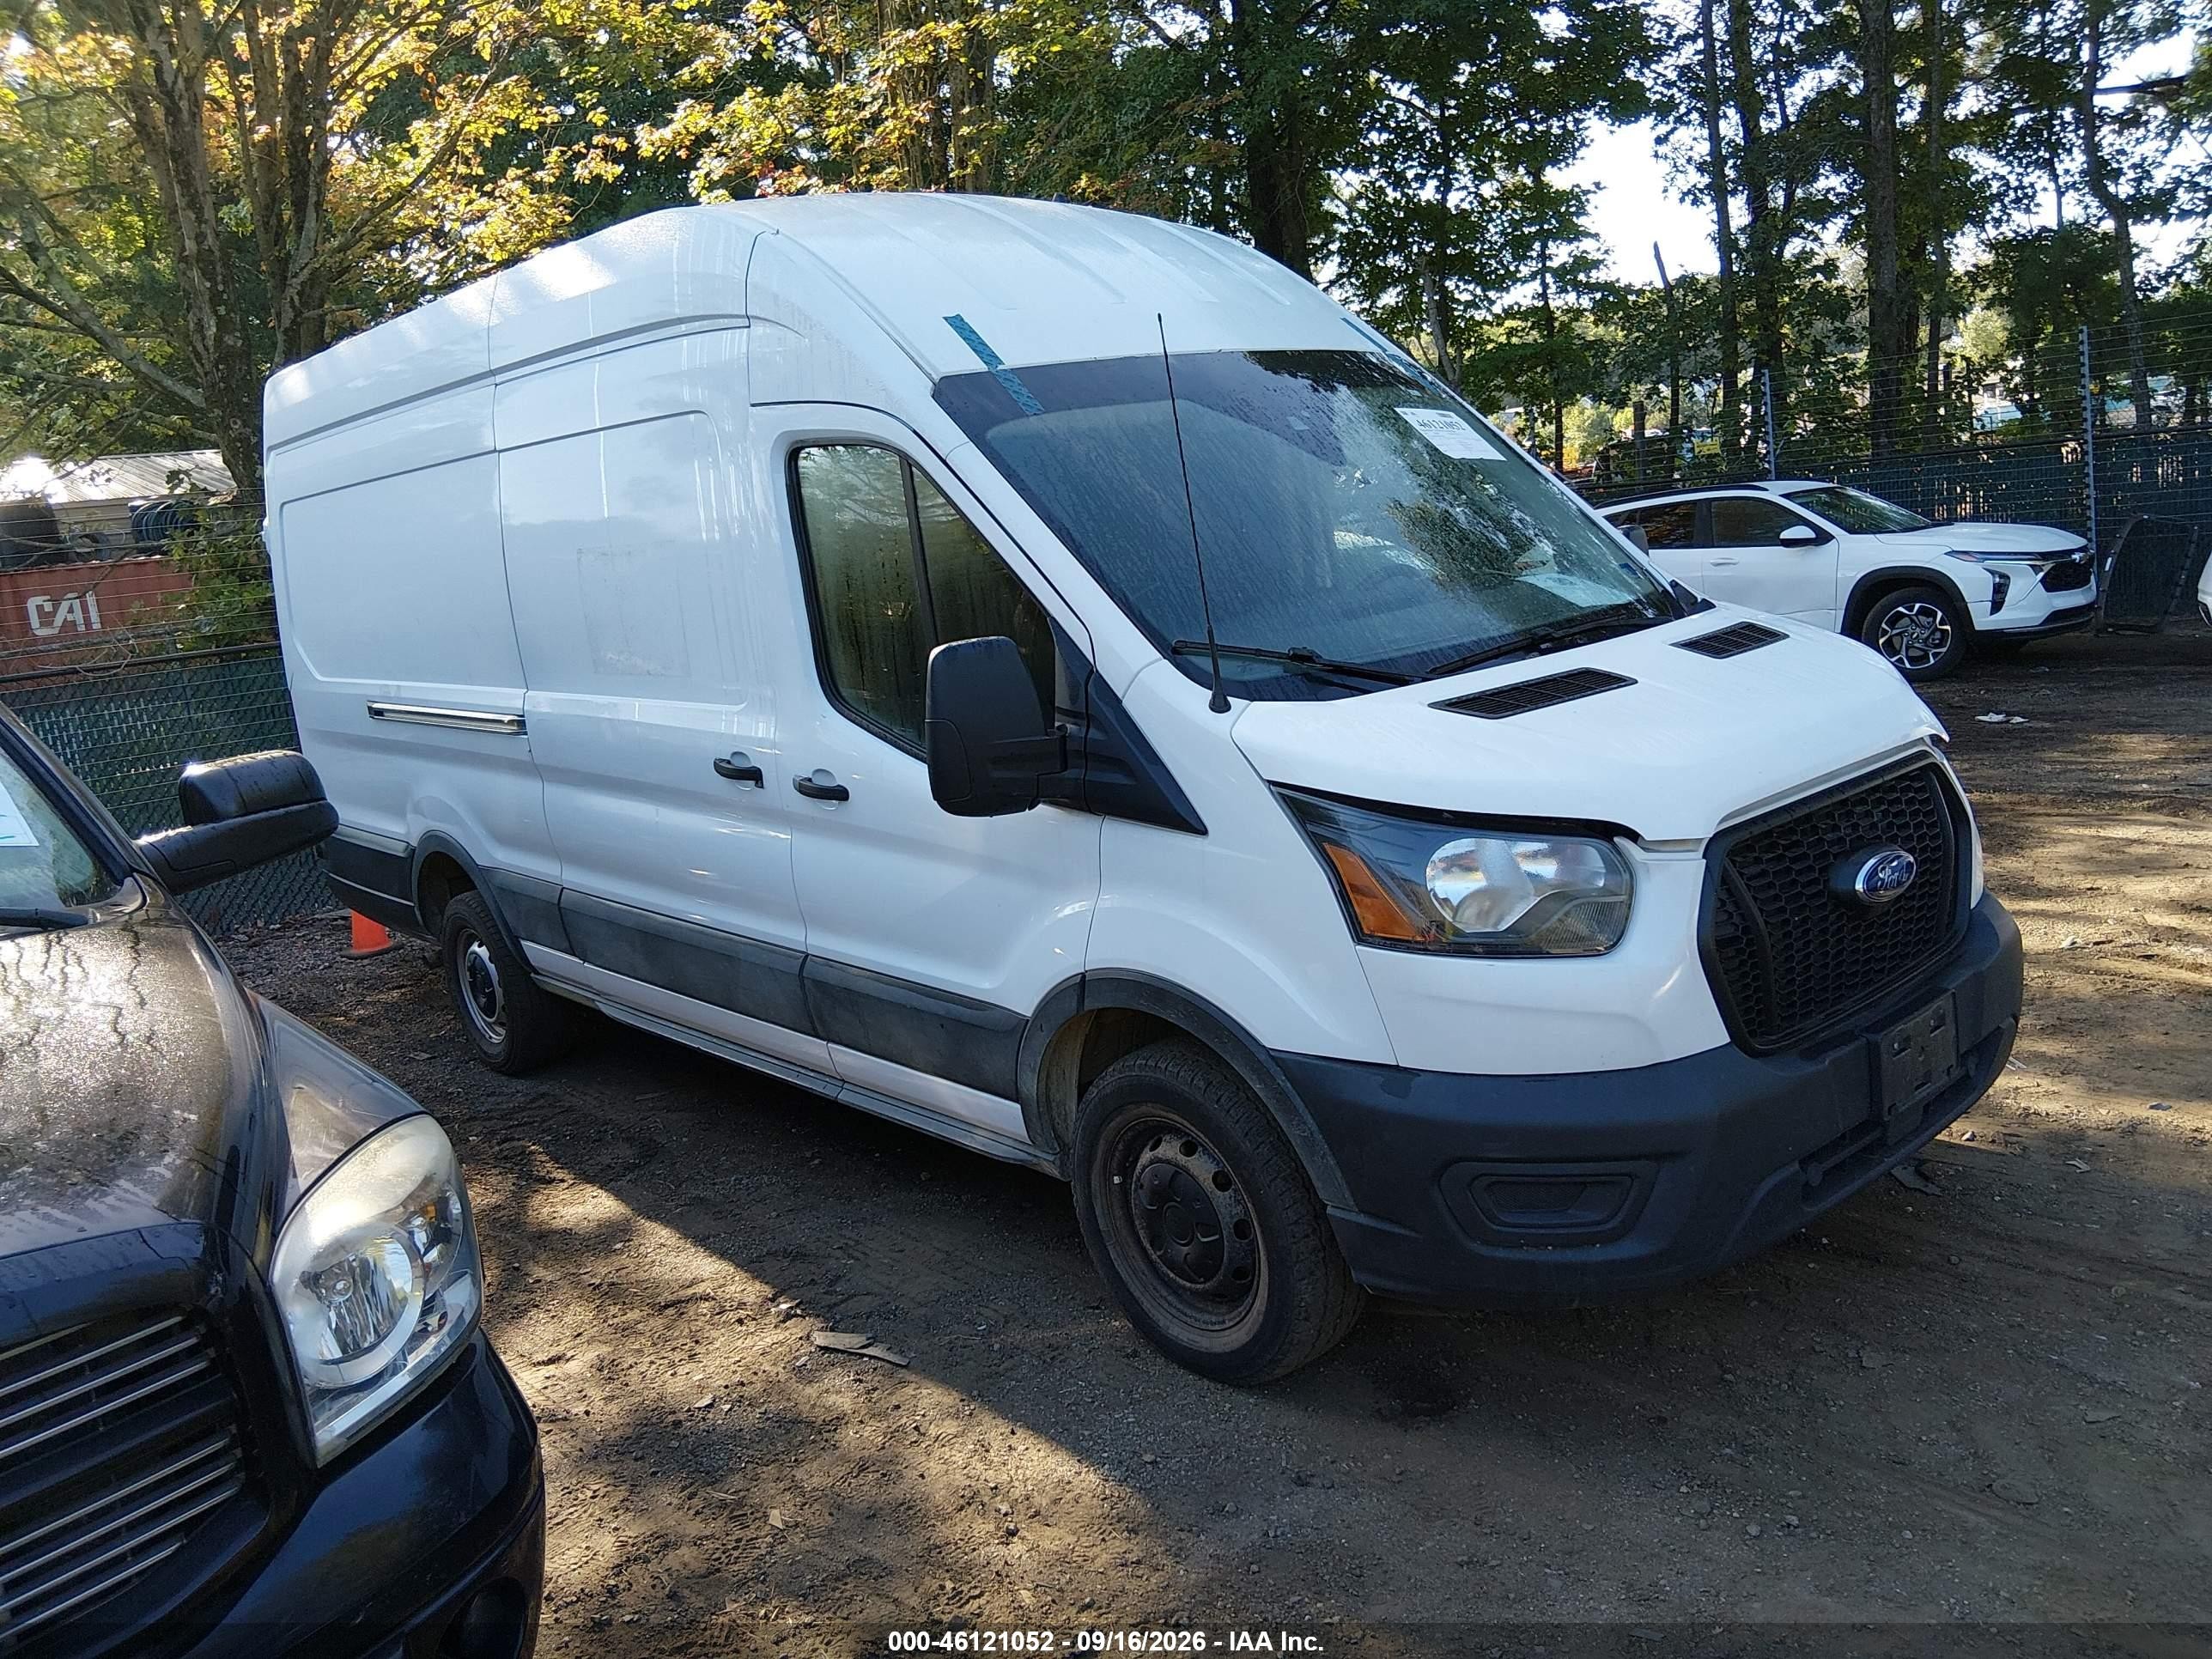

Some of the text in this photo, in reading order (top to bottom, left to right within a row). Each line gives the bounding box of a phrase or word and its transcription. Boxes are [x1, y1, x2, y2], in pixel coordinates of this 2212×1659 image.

[1416, 419, 1466, 431] 46121052
[27, 591, 101, 635] CAI
[1876, 860, 1910, 890] Ford
